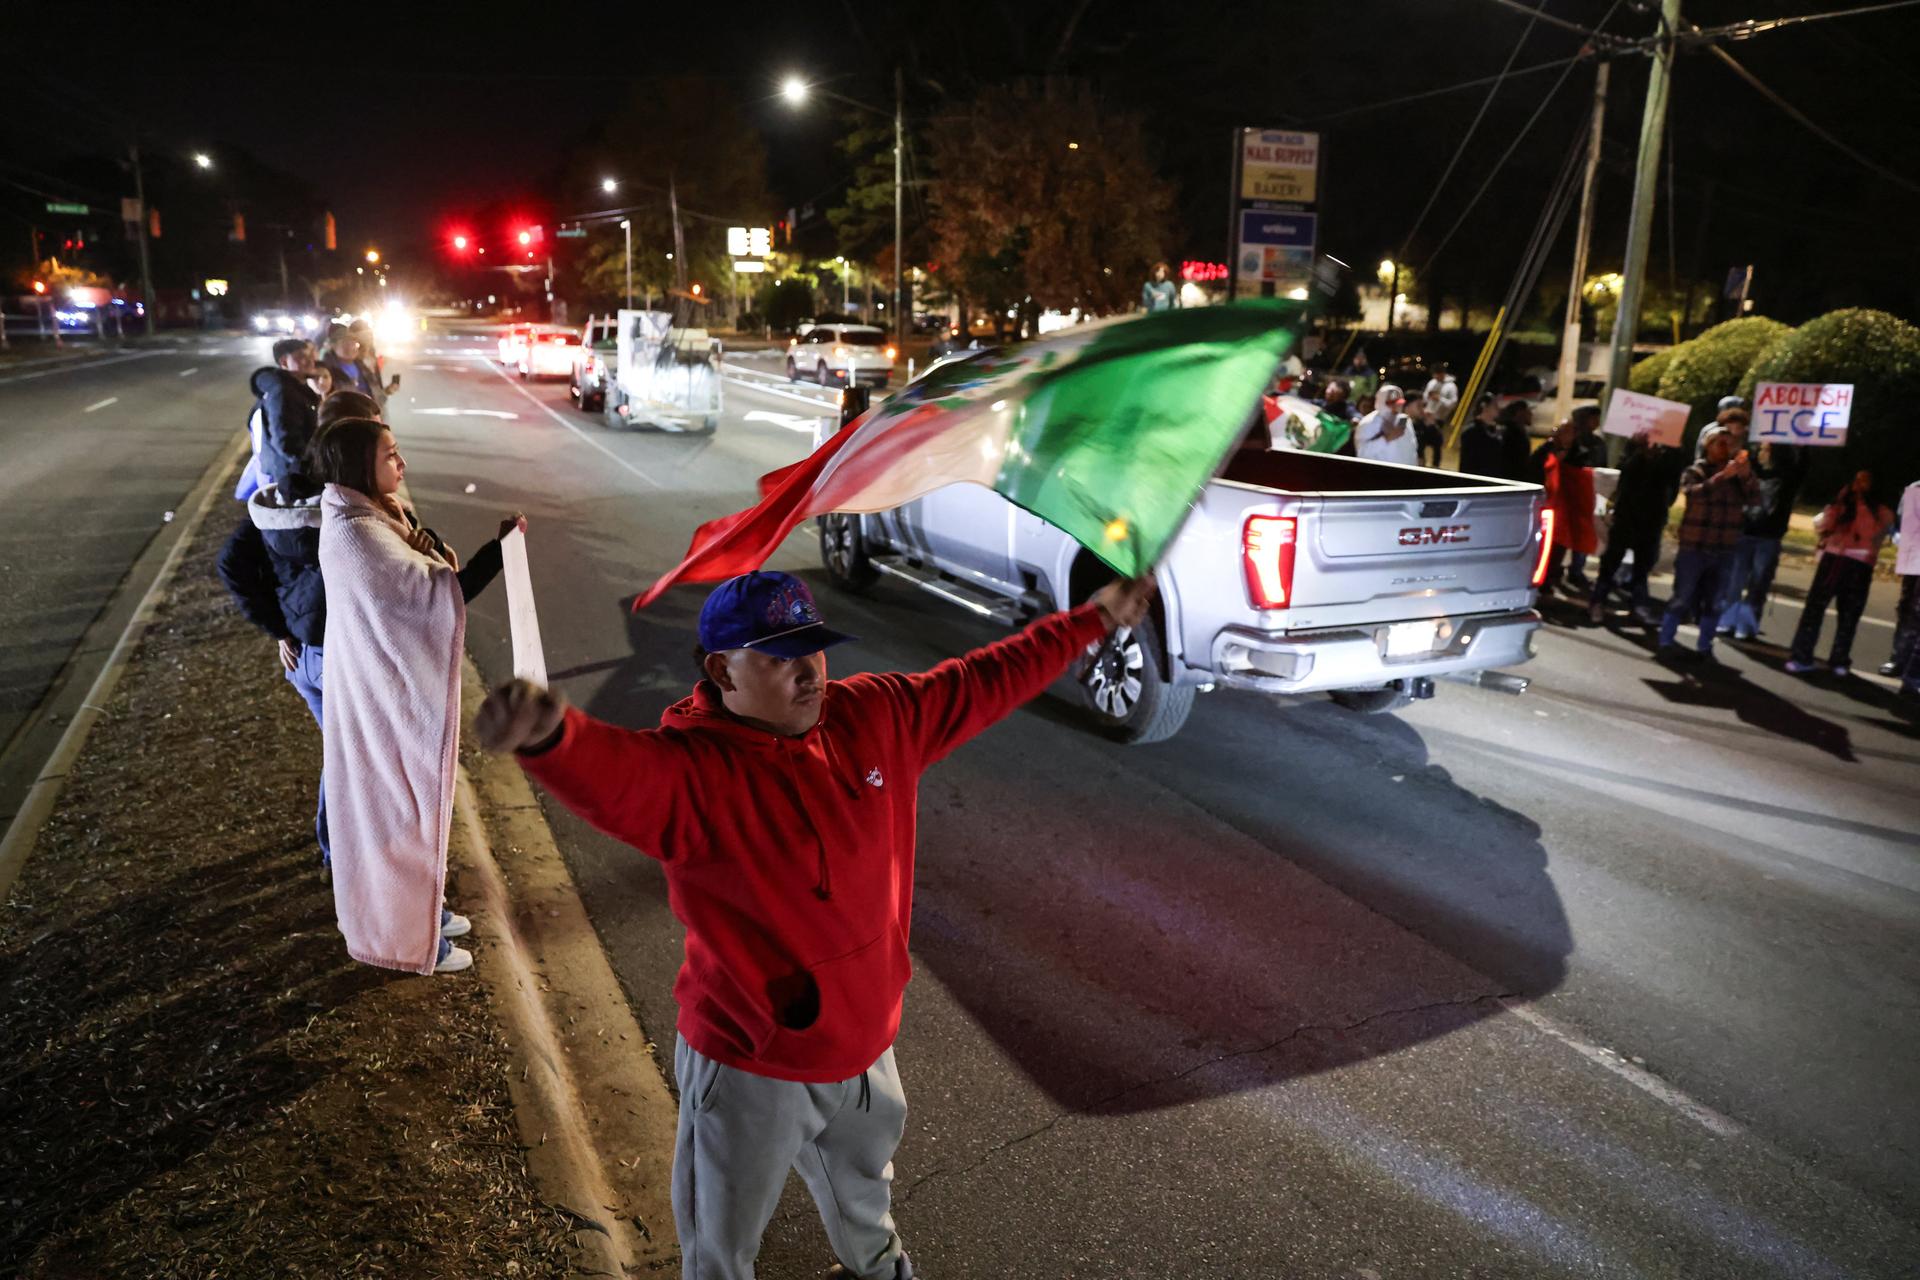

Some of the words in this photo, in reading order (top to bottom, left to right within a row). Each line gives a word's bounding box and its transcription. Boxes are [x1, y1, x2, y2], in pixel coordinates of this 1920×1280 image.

[1757, 385, 1849, 408] ABOLISH
[1760, 409, 1841, 439] ICE
[1398, 524, 1471, 546] GMC
